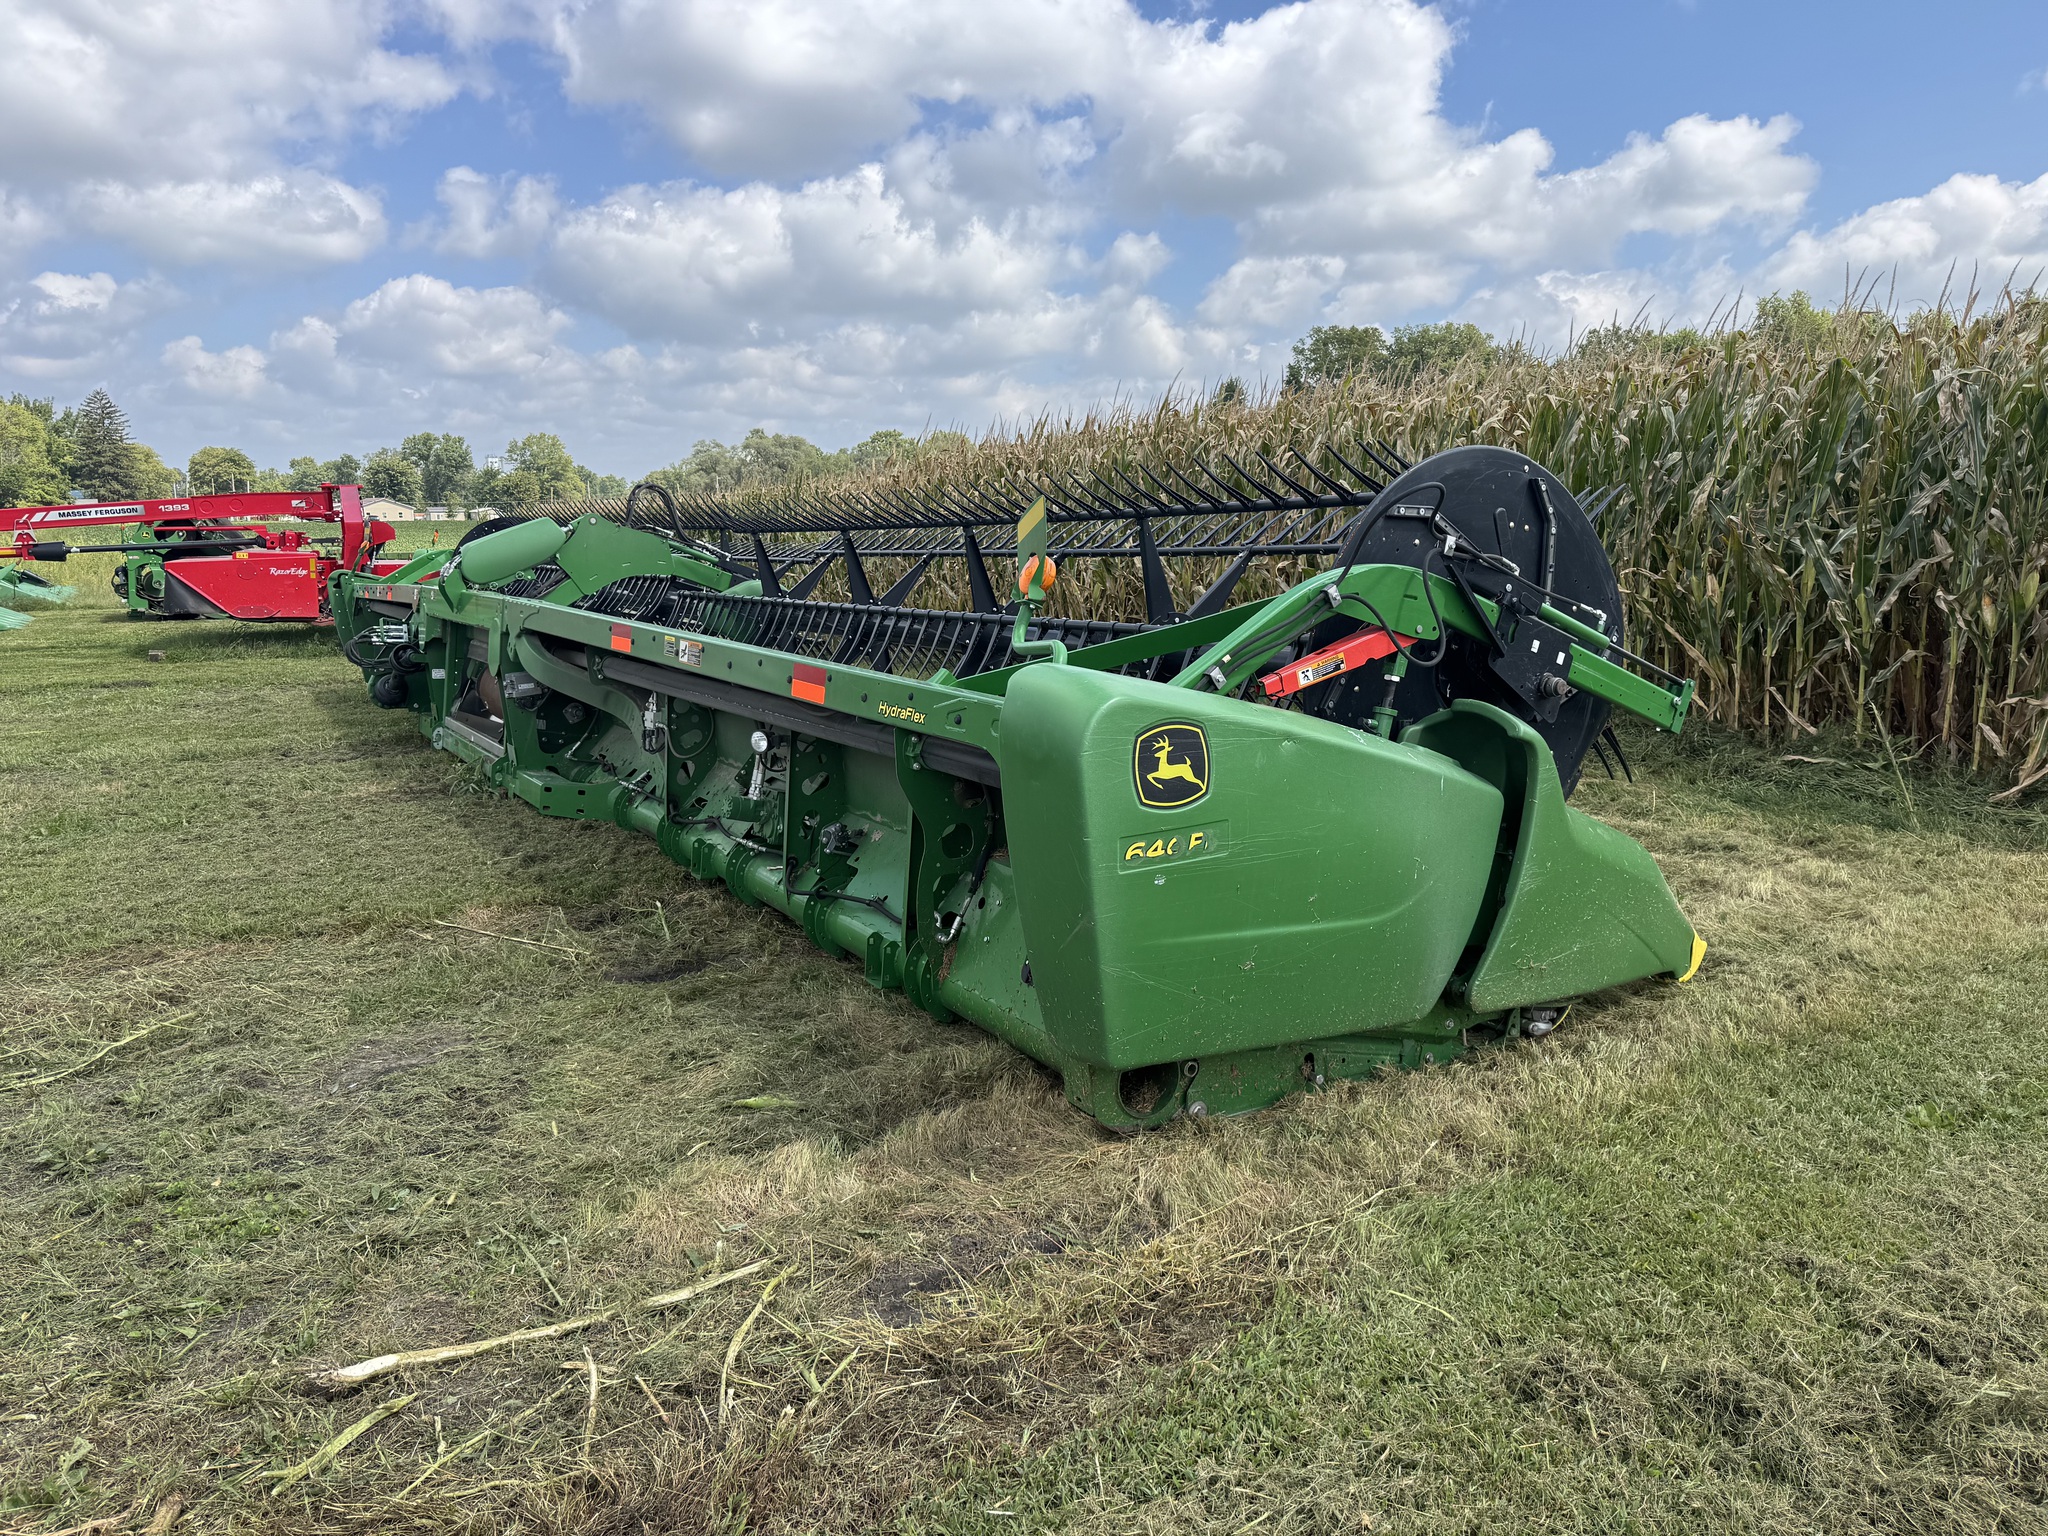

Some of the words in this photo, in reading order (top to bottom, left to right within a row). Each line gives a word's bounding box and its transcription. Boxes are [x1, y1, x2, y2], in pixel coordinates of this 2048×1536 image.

[58, 510, 92, 518] MASSEY
[95, 507, 138, 516] FERGUSON
[158, 503, 190, 512] 1393
[269, 567, 308, 577] RazorEdge
[878, 700, 926, 724] HydraFlex
